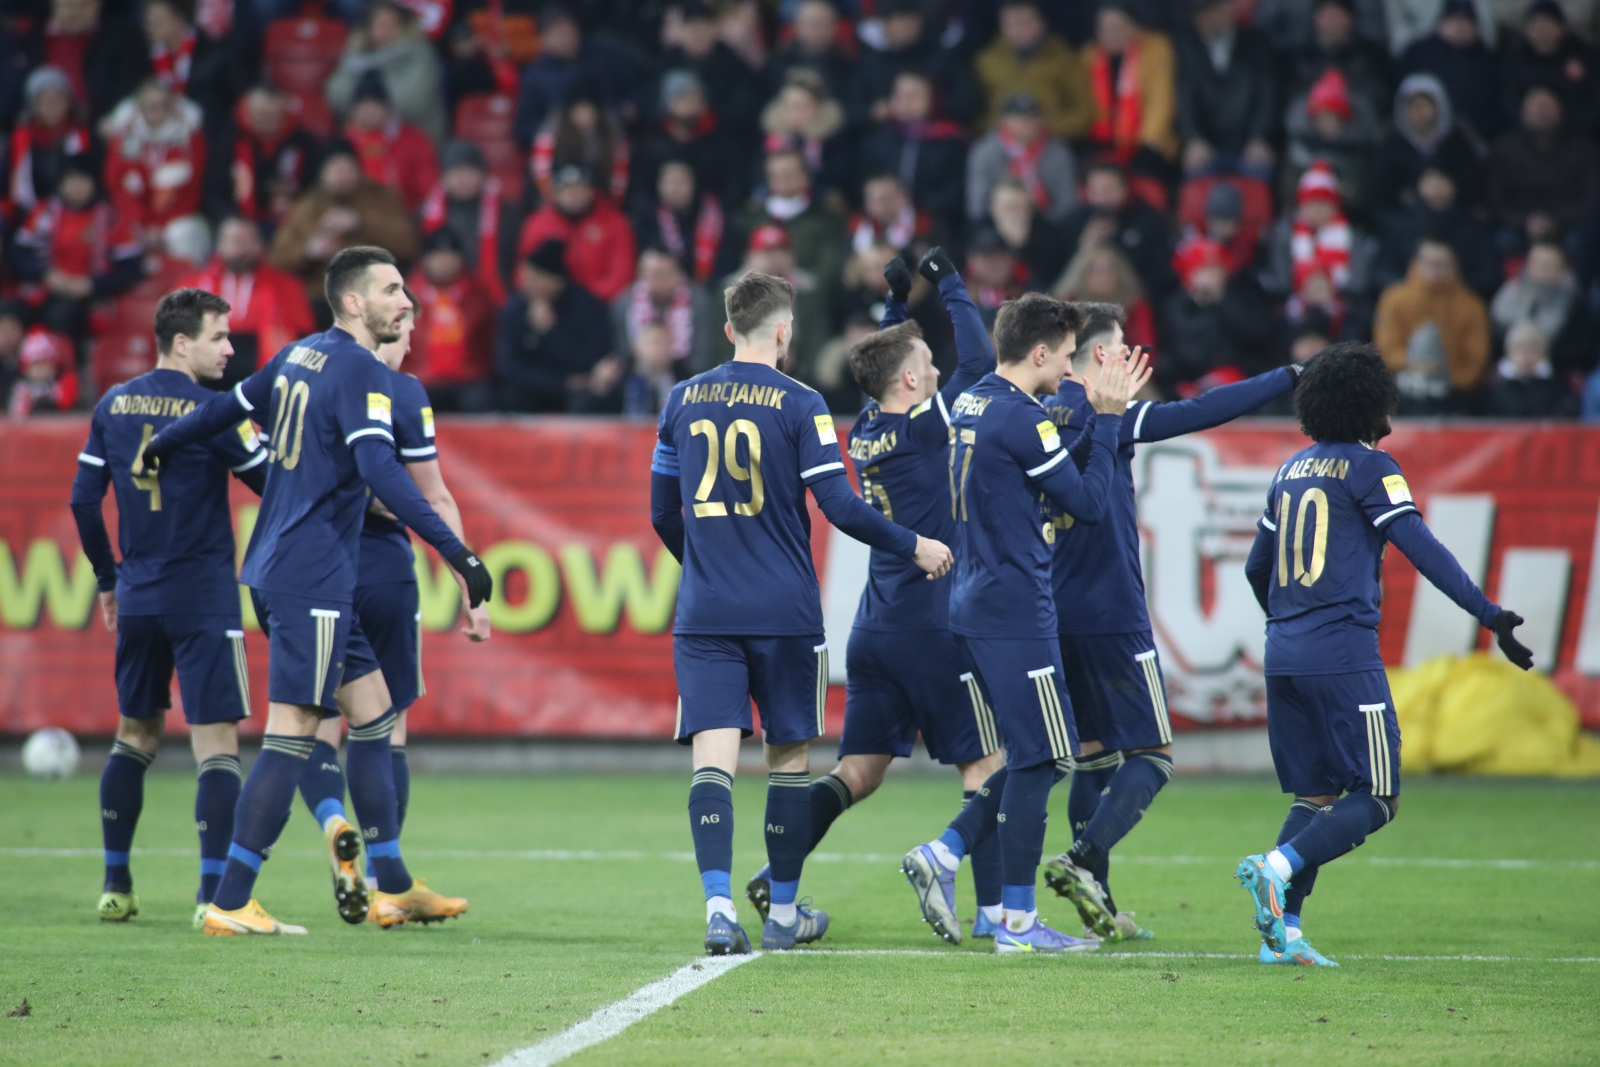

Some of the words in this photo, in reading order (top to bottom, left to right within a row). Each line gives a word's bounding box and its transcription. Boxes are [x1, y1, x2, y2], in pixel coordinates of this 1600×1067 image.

[110, 394, 197, 418] DOBROTKA
[682, 382, 787, 410] MARCJANIK
[131, 422, 162, 512] 4
[689, 418, 765, 518] 29
[1284, 457, 1351, 481] ALEMAN
[1276, 487, 1329, 588] 10
[700, 813, 721, 826] AG
[766, 823, 785, 834] AG
[362, 826, 380, 839] AG
